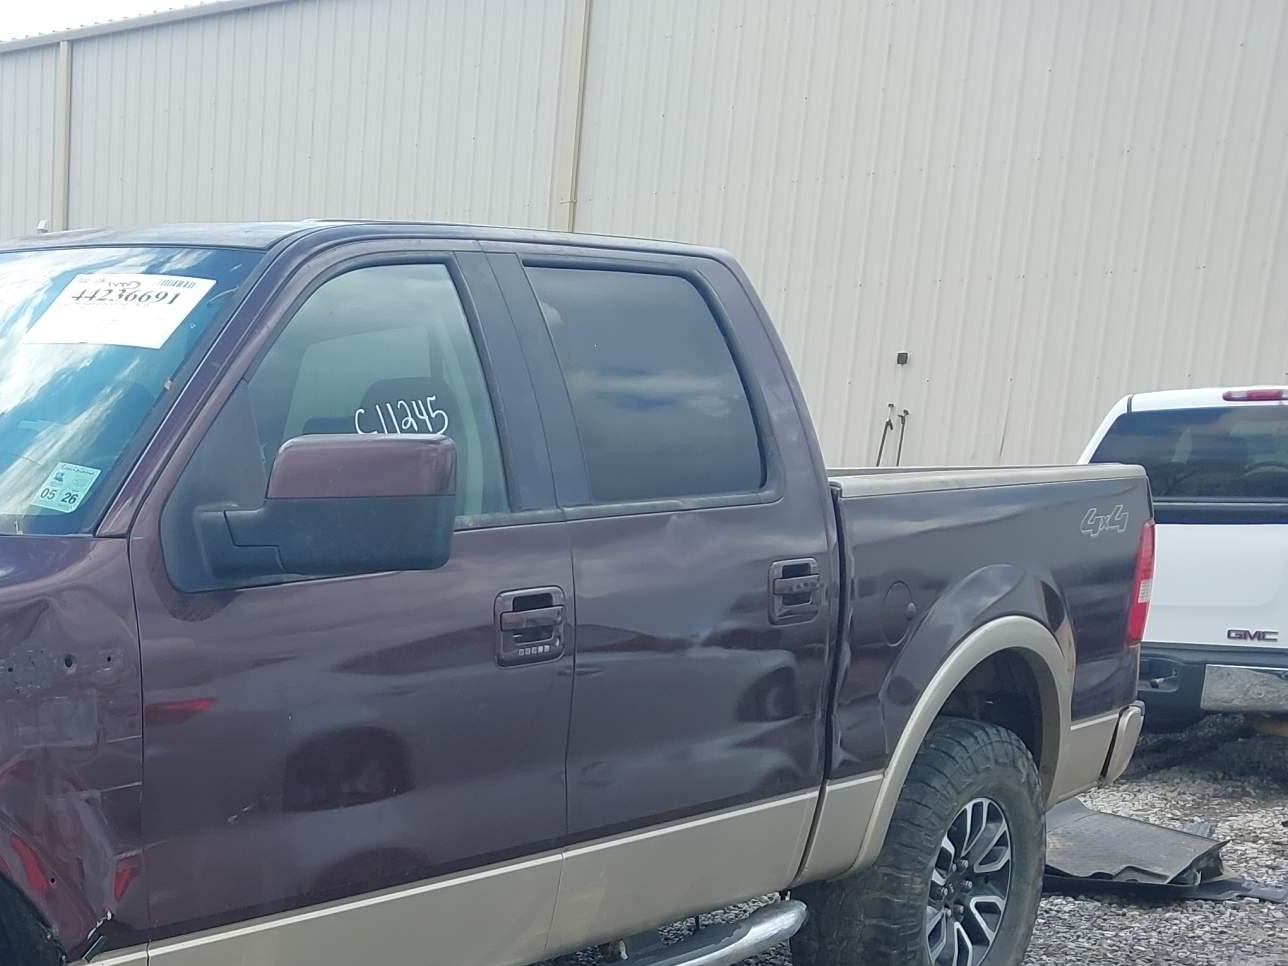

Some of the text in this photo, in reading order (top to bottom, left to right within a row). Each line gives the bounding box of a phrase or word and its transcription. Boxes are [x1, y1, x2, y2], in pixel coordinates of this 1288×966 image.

[71, 288, 182, 305] 44236691
[354, 394, 449, 435] C11245
[40, 487, 79, 505] 05 26
[1079, 504, 1129, 537] 4x4
[1226, 629, 1279, 642] GMC
